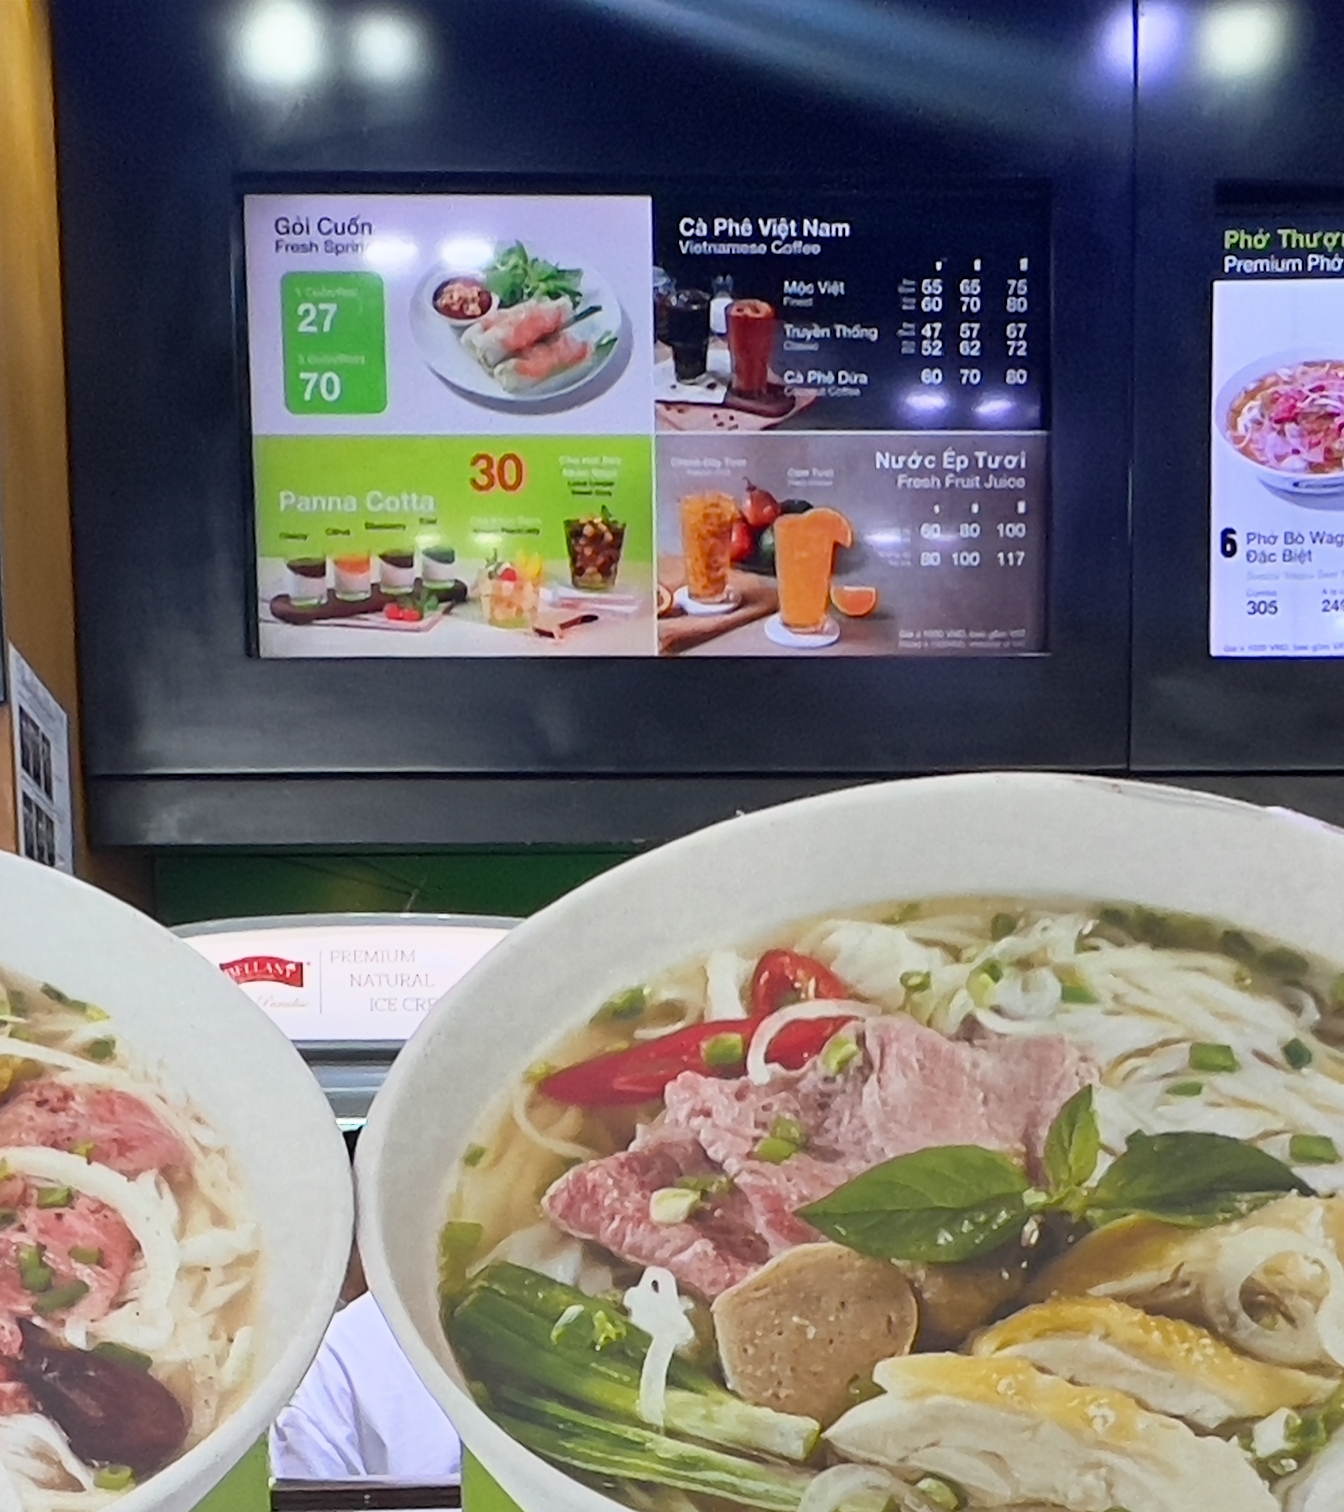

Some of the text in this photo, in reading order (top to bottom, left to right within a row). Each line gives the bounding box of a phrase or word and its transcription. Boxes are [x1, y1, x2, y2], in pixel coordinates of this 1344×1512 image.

[274, 214, 372, 236] Gỏi Cuốn
[679, 217, 850, 240] Cà Phê Việt Nam
[1224, 228, 1270, 249] Phở
[275, 240, 366, 256] Fresh Sprin
[679, 240, 821, 255] Vietnamese Coffee
[1224, 253, 1344, 273] Premium Phở
[817, 281, 845, 296] Việt
[1007, 279, 1028, 295] 75
[921, 297, 1028, 312] 60 70 80
[297, 303, 337, 333] 27
[784, 323, 831, 341] Truyền
[921, 322, 942, 338] 47
[1006, 322, 1028, 338] 67
[960, 340, 981, 356] 62
[1007, 340, 1028, 356] 72
[921, 368, 1028, 385] 60 70 80
[299, 371, 340, 401] 70
[875, 446, 1026, 472] Nước Ép Tươi
[470, 453, 523, 491] 30
[897, 474, 1026, 489] Fresh Fruit Juice
[279, 491, 435, 513] Panna Cotta
[959, 523, 980, 538] 80
[997, 523, 1026, 538] 100
[1220, 527, 1237, 558] 6
[1246, 531, 1278, 545] Phở
[1284, 530, 1304, 545] Bò
[952, 552, 980, 566] 100
[997, 552, 1025, 566] 117
[1282, 548, 1312, 565] Biệt
[1247, 600, 1278, 615] 305
[330, 950, 416, 964] PREMIUM
[350, 973, 435, 988] NATURAL
[370, 998, 397, 1012] ICE
